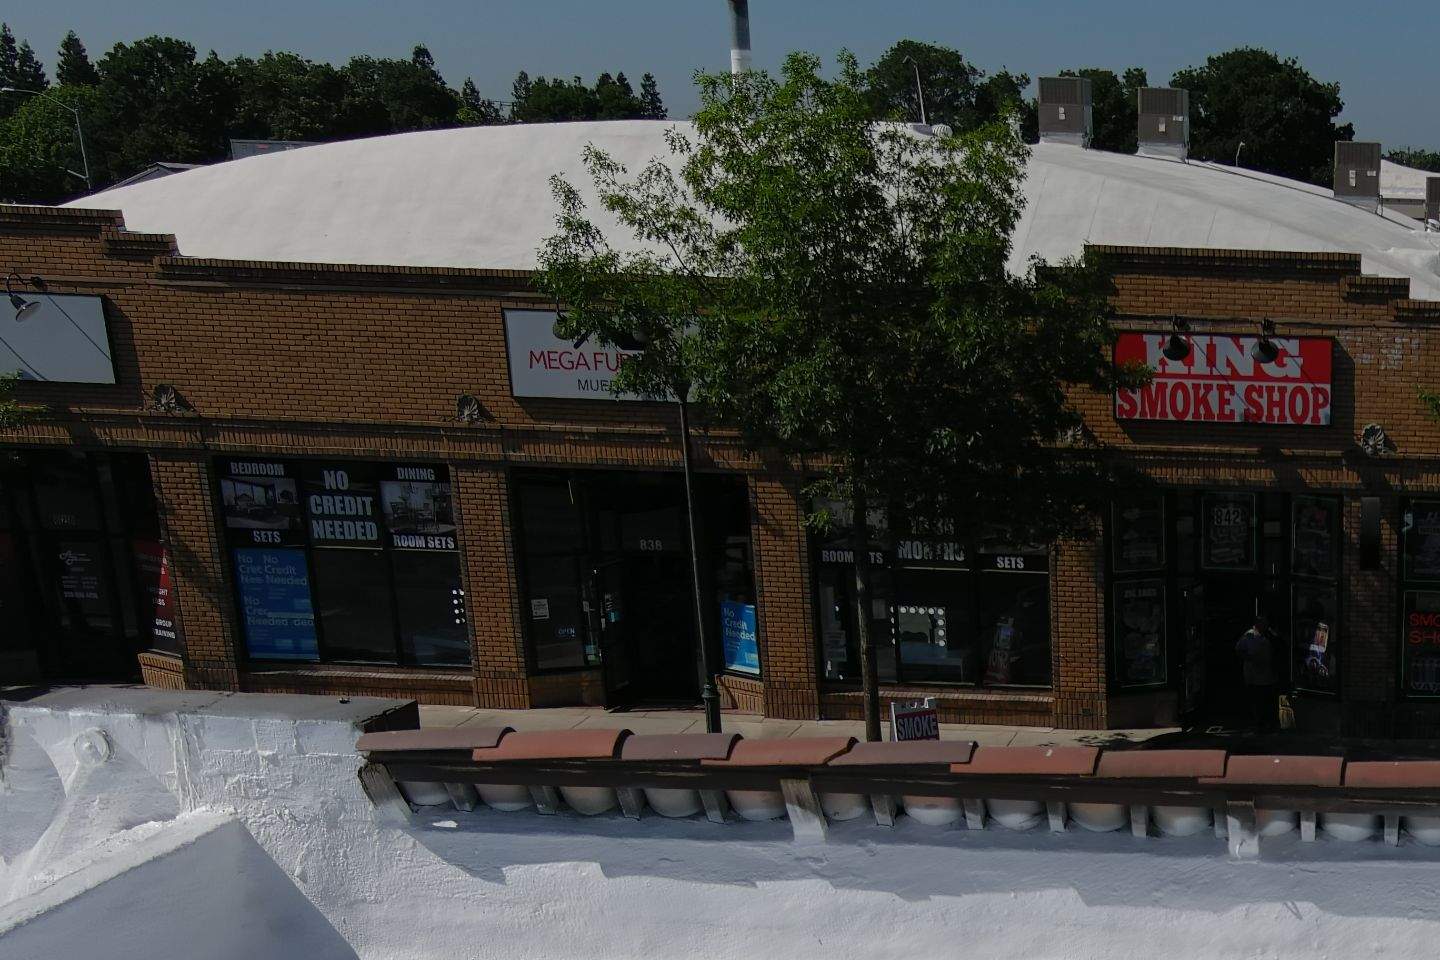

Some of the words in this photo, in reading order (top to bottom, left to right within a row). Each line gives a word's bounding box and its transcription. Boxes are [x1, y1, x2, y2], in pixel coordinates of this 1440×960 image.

[529, 350, 591, 371] MEGA
[1143, 334, 1304, 378] KING
[1117, 380, 1236, 421] SMOKE
[1244, 384, 1330, 424] SHOP
[230, 461, 285, 477] BEDROOM
[396, 466, 436, 481] DINING
[323, 470, 351, 491] NO
[309, 494, 374, 516] CREDIT
[253, 529, 283, 544] SETS
[311, 518, 379, 541] NEEDED
[393, 534, 426, 549] ROOM
[427, 536, 456, 550] SETS
[639, 538, 663, 551] 838
[821, 549, 854, 563] ROOM
[996, 556, 1025, 569] SETS
[264, 564, 297, 576] Credit
[897, 715, 938, 740] SMOKE
